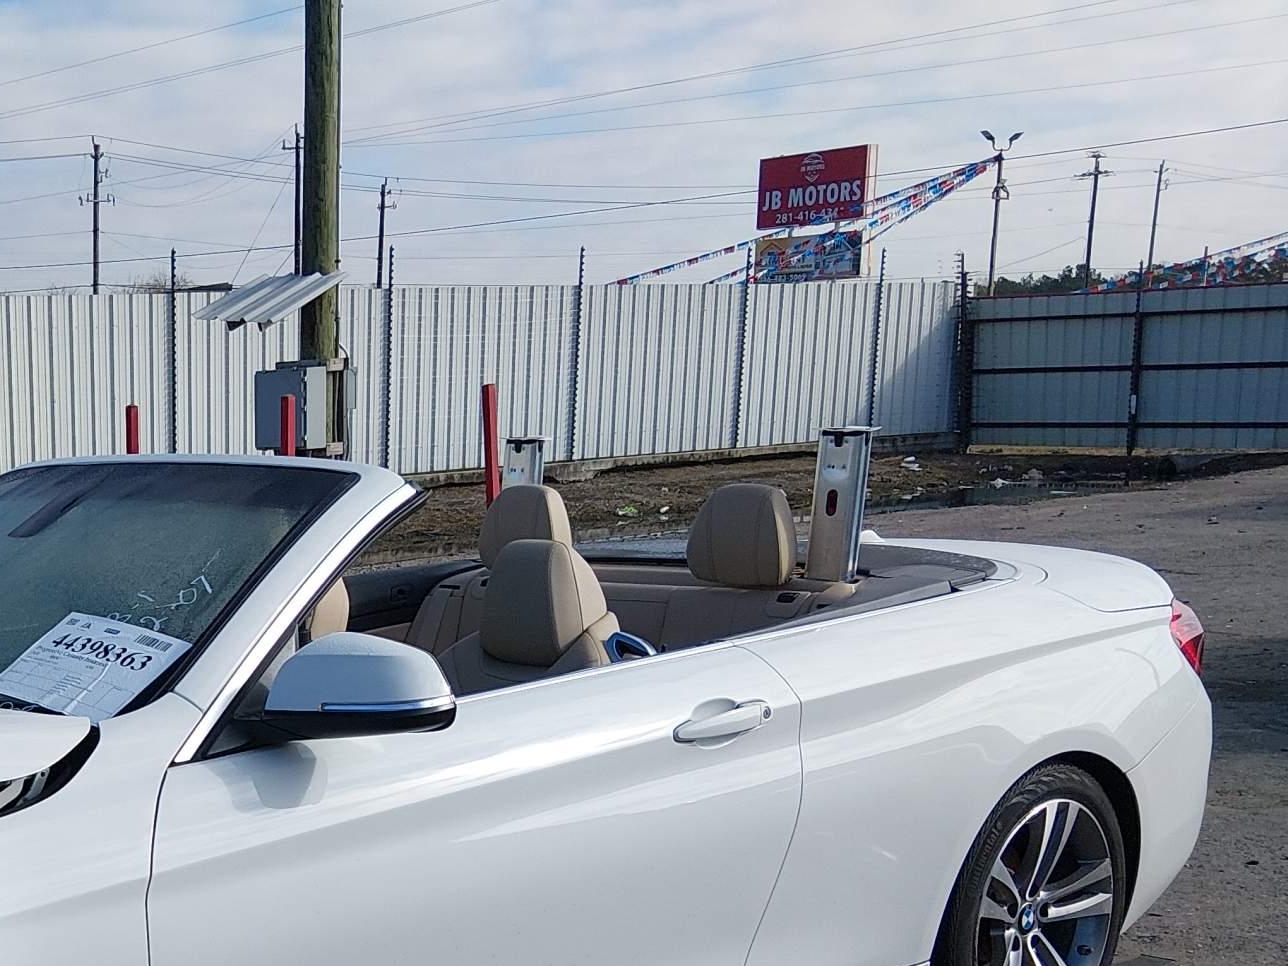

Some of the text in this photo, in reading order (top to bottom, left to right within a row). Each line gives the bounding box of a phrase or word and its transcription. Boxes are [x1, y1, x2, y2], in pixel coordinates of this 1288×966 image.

[762, 180, 862, 212] JB MOTORS
[52, 633, 152, 671] 44398363
